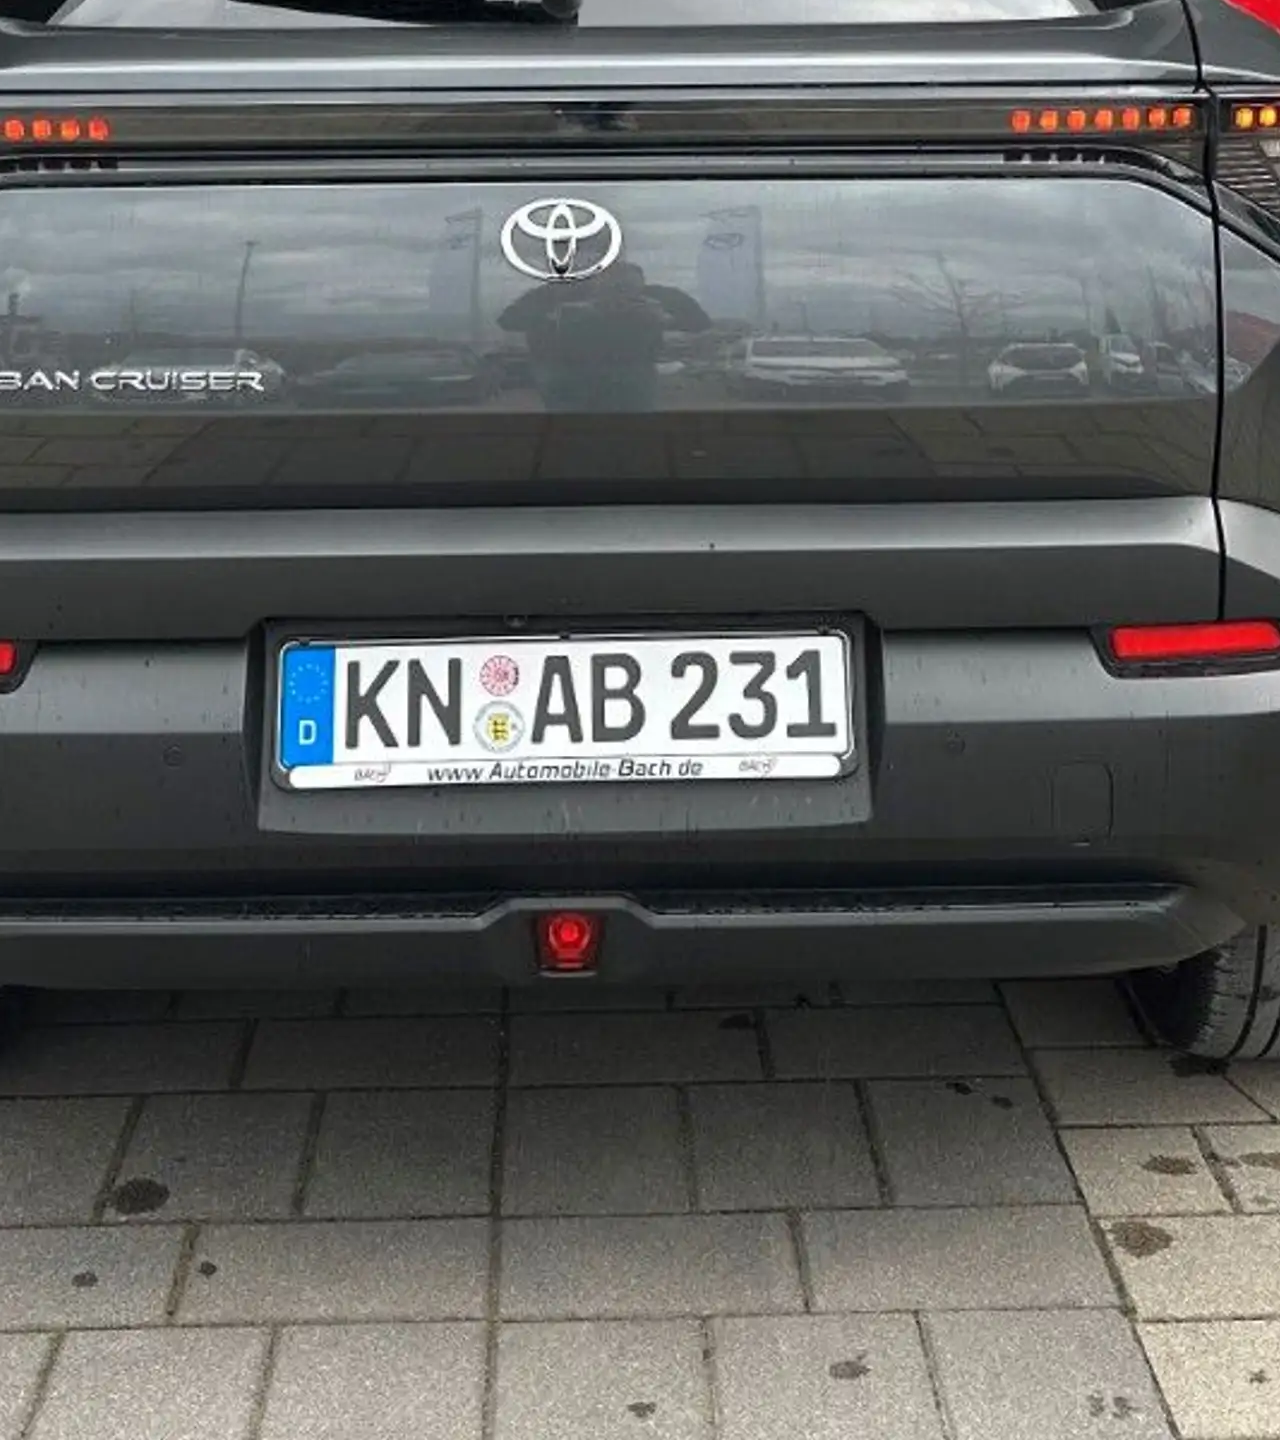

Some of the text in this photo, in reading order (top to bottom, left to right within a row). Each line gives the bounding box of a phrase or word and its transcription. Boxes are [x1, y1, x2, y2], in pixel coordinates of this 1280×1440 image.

[90, 370, 265, 391] CRUISER
[298, 650, 837, 749] D KN AB 231
